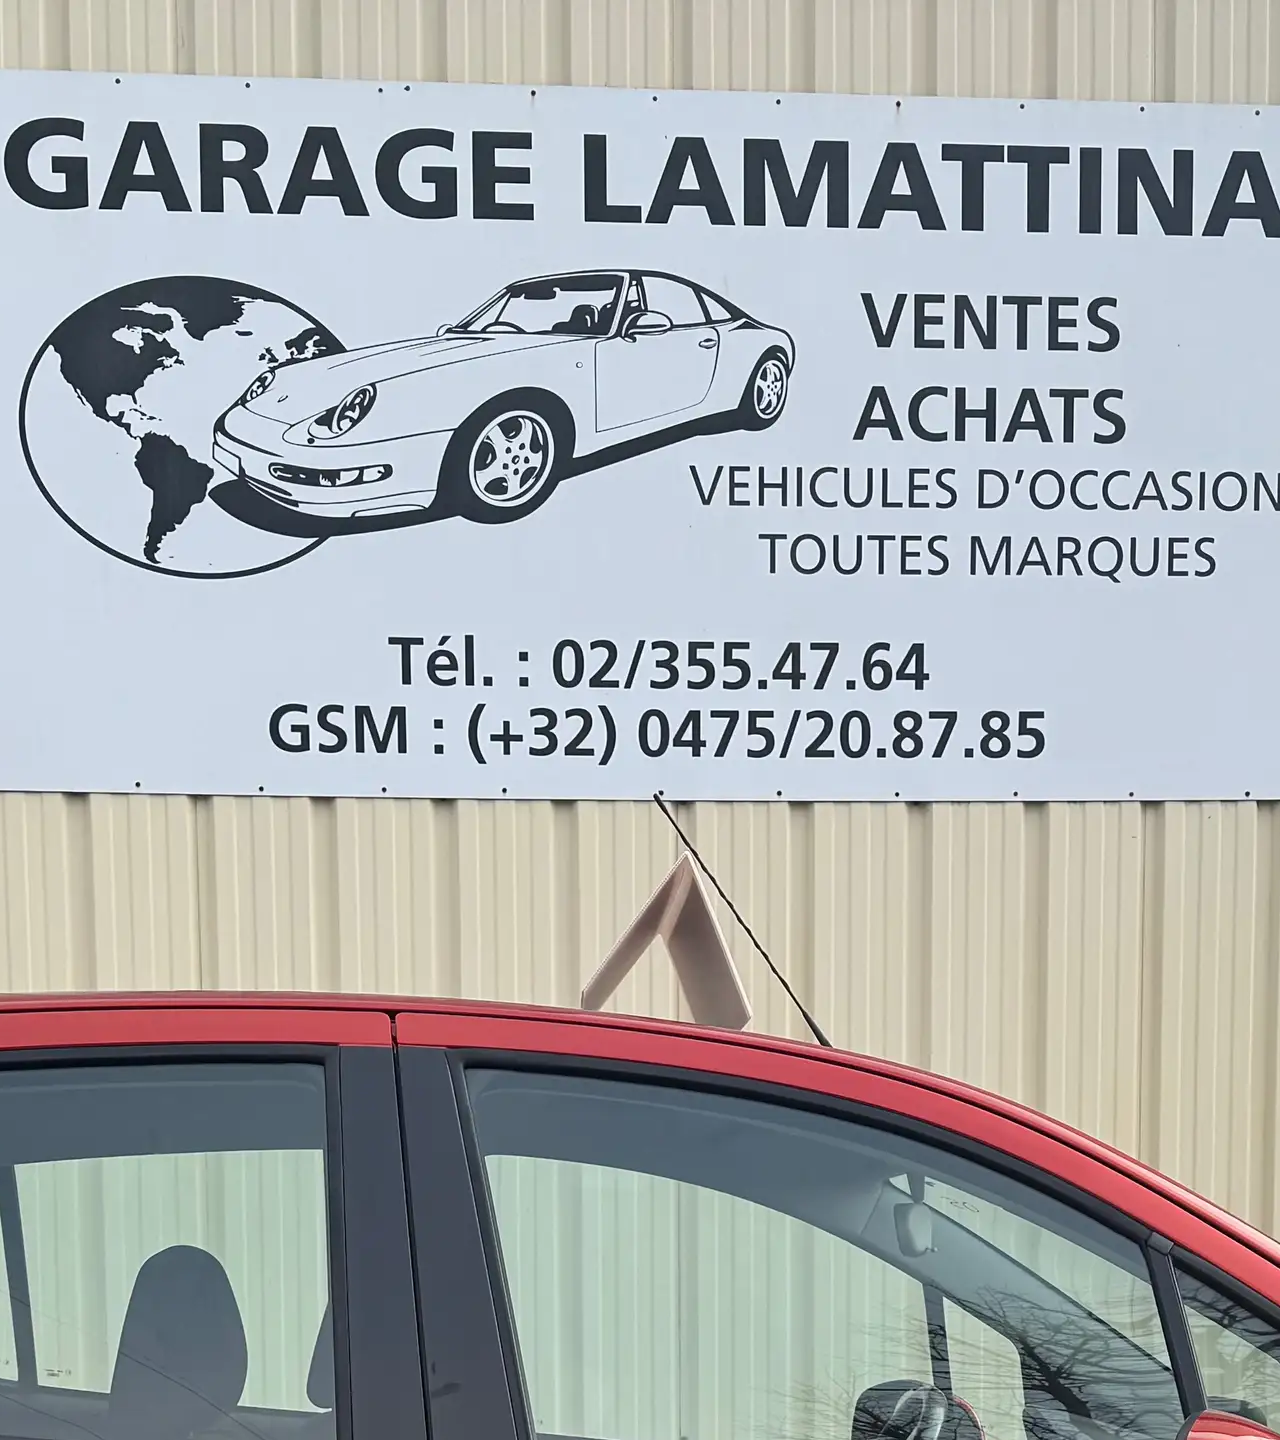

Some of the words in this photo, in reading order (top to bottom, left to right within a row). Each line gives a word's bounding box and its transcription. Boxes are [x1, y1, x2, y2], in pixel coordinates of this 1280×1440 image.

[3, 117, 535, 221] GARAGE
[860, 292, 1121, 353] VENTES
[852, 385, 1126, 445] ACHATS
[689, 465, 958, 509] VEHICULES
[758, 533, 950, 576] TOUTES
[970, 535, 1216, 584] MARQUES
[387, 634, 493, 687] Tél.
[552, 639, 930, 691] 02/355.47.64
[269, 703, 407, 754] GSM
[467, 703, 617, 766] (+32)
[638, 708, 1045, 759] 0475/20.87.85
